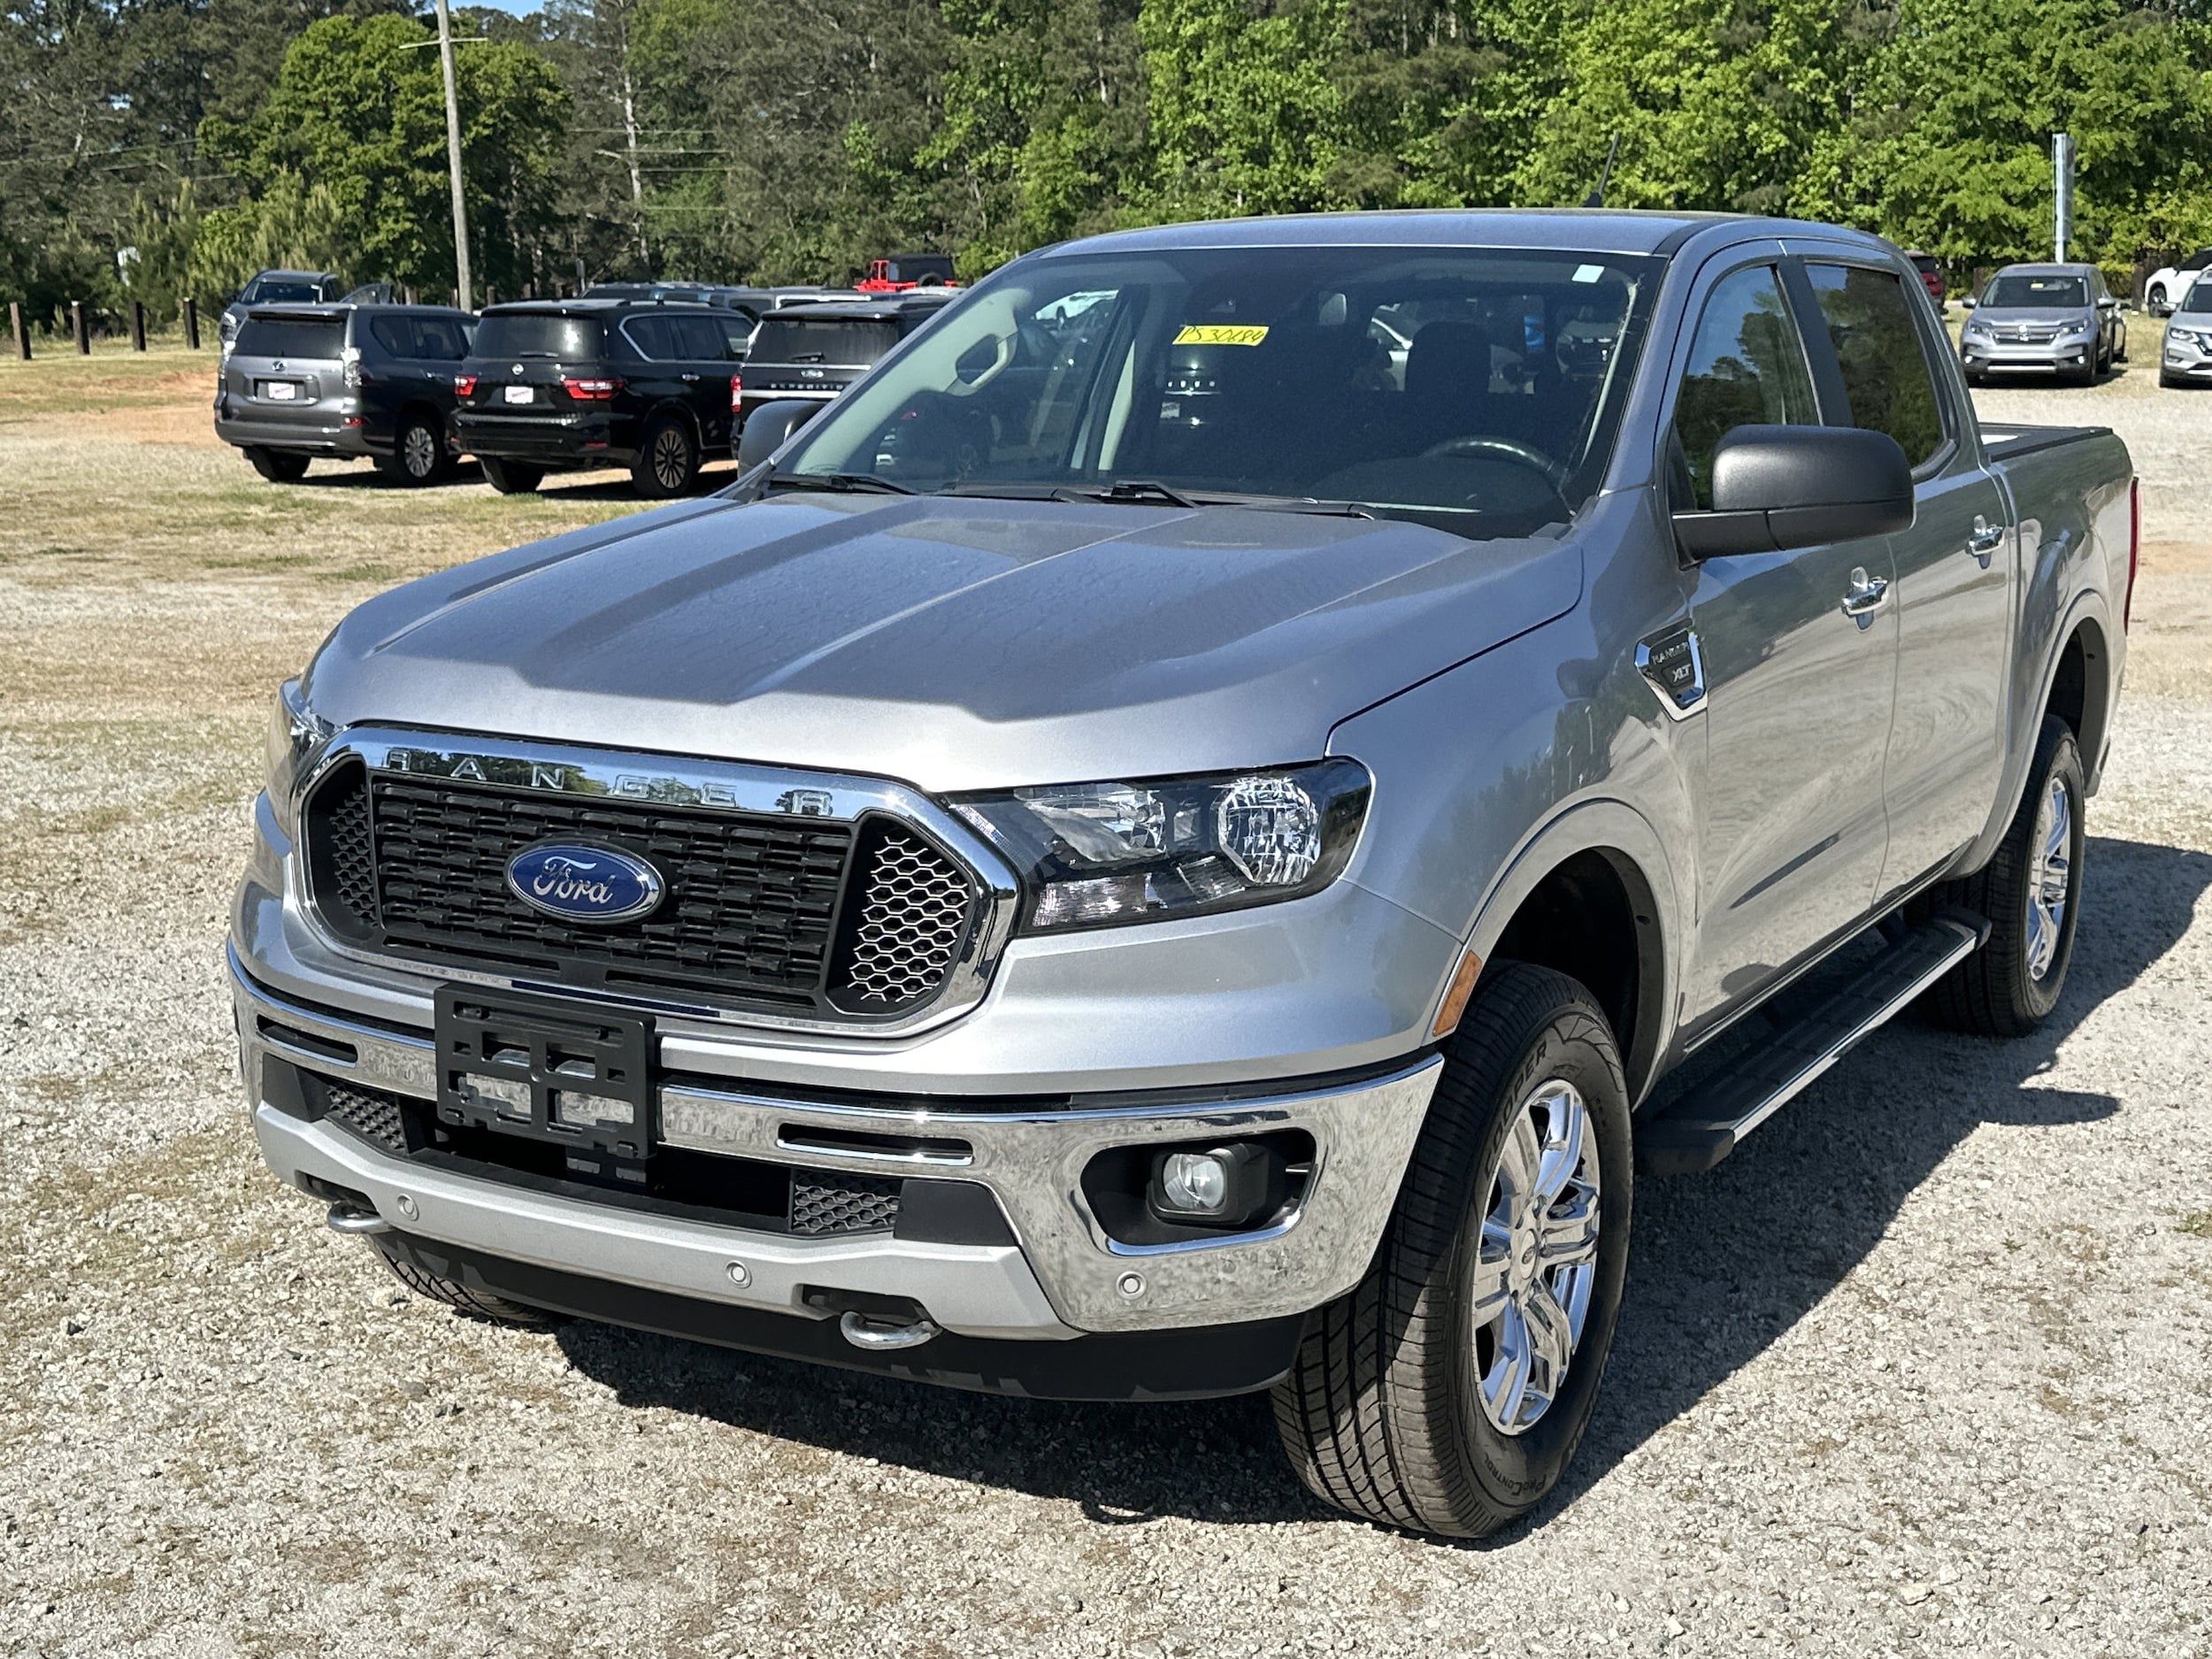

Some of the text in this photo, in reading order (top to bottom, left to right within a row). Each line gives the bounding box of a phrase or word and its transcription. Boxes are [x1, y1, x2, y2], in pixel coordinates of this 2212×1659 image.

[1672, 664, 1691, 682] XLT
[382, 748, 833, 816] RANGER
[533, 856, 615, 905] Ford
[1485, 1040, 1547, 1180] COOPER
